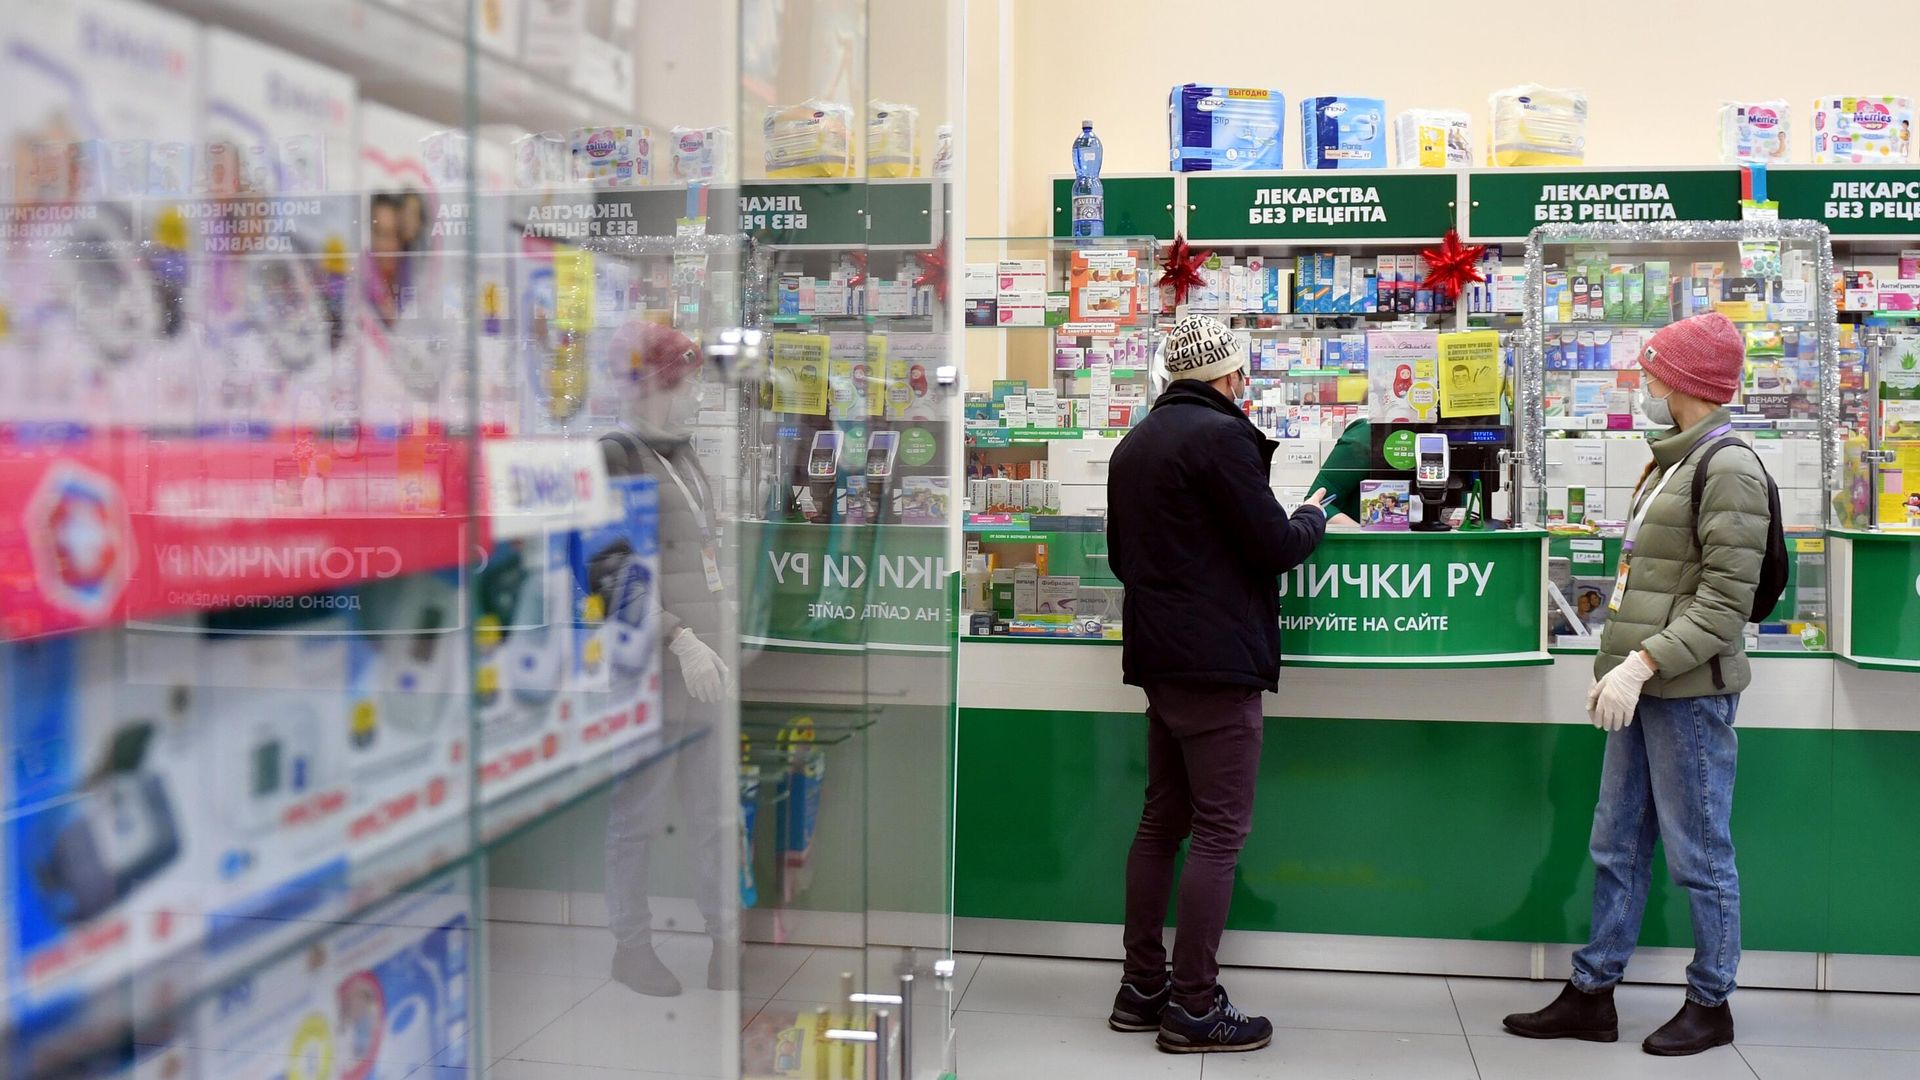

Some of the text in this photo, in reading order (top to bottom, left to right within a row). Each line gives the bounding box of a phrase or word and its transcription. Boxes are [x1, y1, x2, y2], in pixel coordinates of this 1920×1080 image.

[1228, 89, 1268, 97] ВЫГОДНО
[1214, 116, 1230, 126] Slip
[1748, 115, 1778, 125] Merries
[1853, 111, 1892, 123] Merries
[1341, 142, 1362, 150] Pants
[1255, 187, 1380, 205] ЛЕКАРСТВА
[1540, 183, 1670, 201] ЛЕКАРСТВА
[1830, 181, 1920, 199] ЛЕКАРС
[1249, 206, 1387, 226] БЕЗ РЕЦЕПТА
[1535, 202, 1677, 222] БЕЗ РЕЦЕПТА
[1825, 202, 1864, 218] БЕЗ
[1749, 396, 1789, 404] ВЕНАРУС
[1447, 561, 1495, 597] РУ
[1363, 616, 1389, 631] НА
[1394, 612, 1448, 631] САЙТЕ
